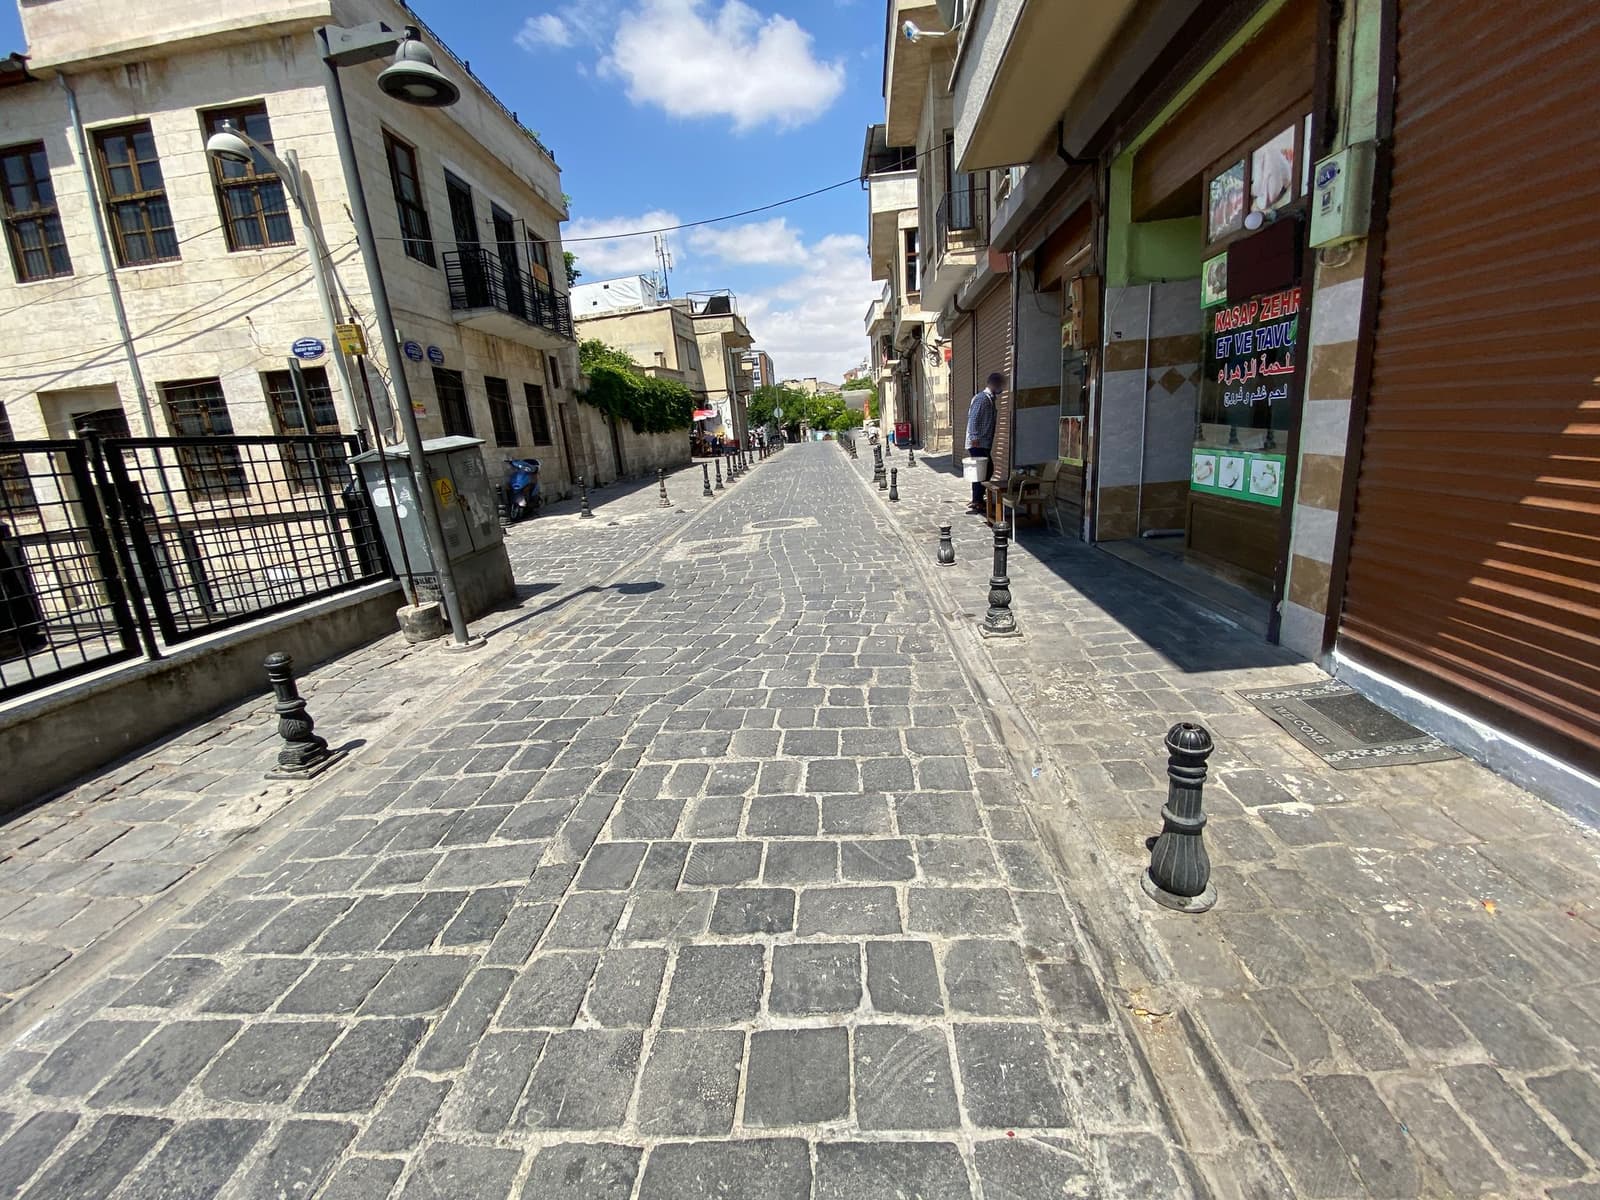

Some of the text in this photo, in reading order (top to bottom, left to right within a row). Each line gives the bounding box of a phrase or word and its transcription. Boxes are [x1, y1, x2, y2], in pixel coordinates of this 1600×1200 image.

[1215, 300, 1259, 334] KASAP
[1216, 321, 1297, 359] ET VE TAVU
[1217, 357, 1257, 386] الزهراء
[1268, 383, 1288, 407] لحم
[1273, 705, 1331, 746] WELCOME
